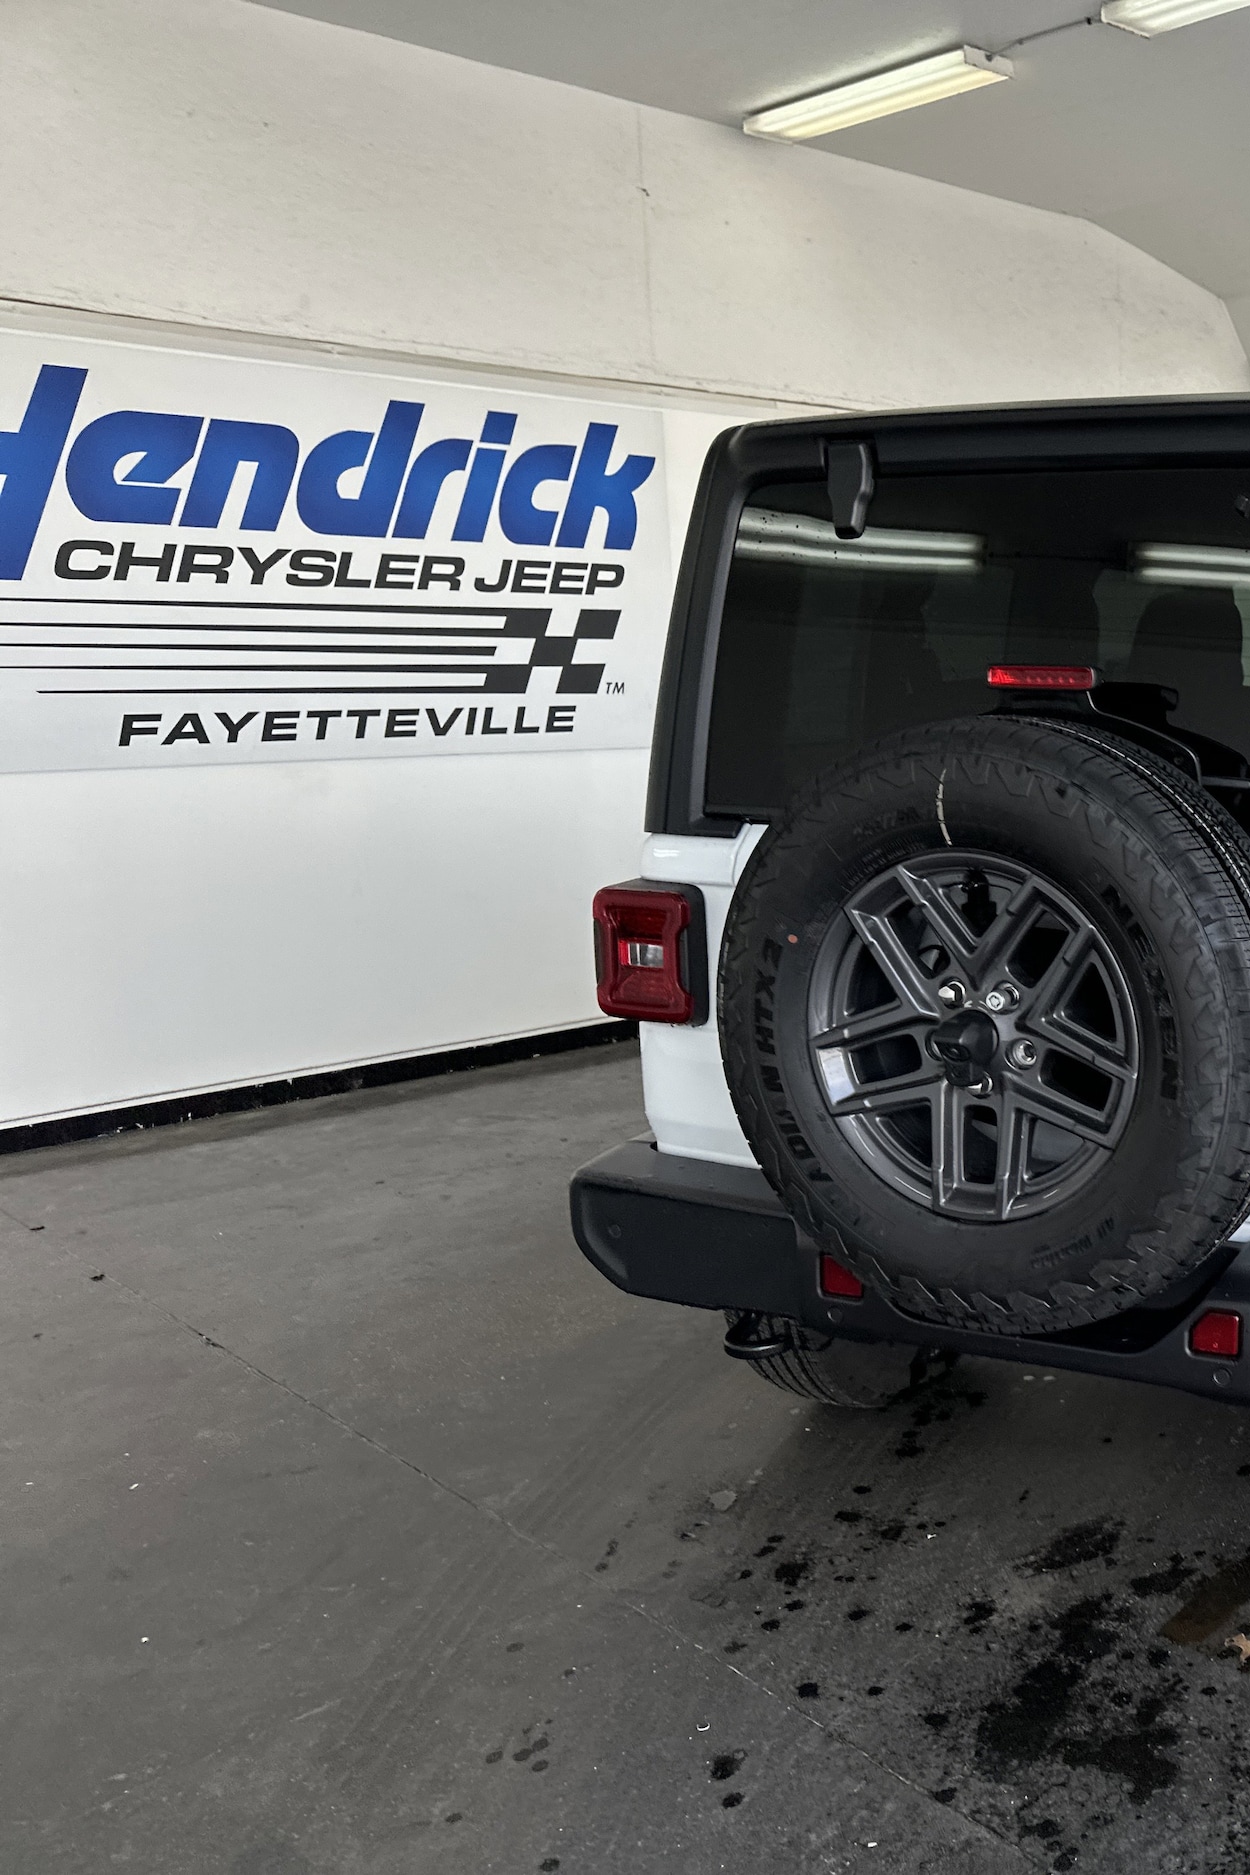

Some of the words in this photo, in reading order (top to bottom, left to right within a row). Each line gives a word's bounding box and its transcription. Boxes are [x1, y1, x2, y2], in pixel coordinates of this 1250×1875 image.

[55, 540, 466, 591] CHRYSLER
[475, 560, 625, 595] JEEP
[606, 682, 625, 695] TM
[119, 705, 577, 746] FAYETTEVILLE
[760, 937, 784, 970] 2
[751, 967, 779, 1056] HTX
